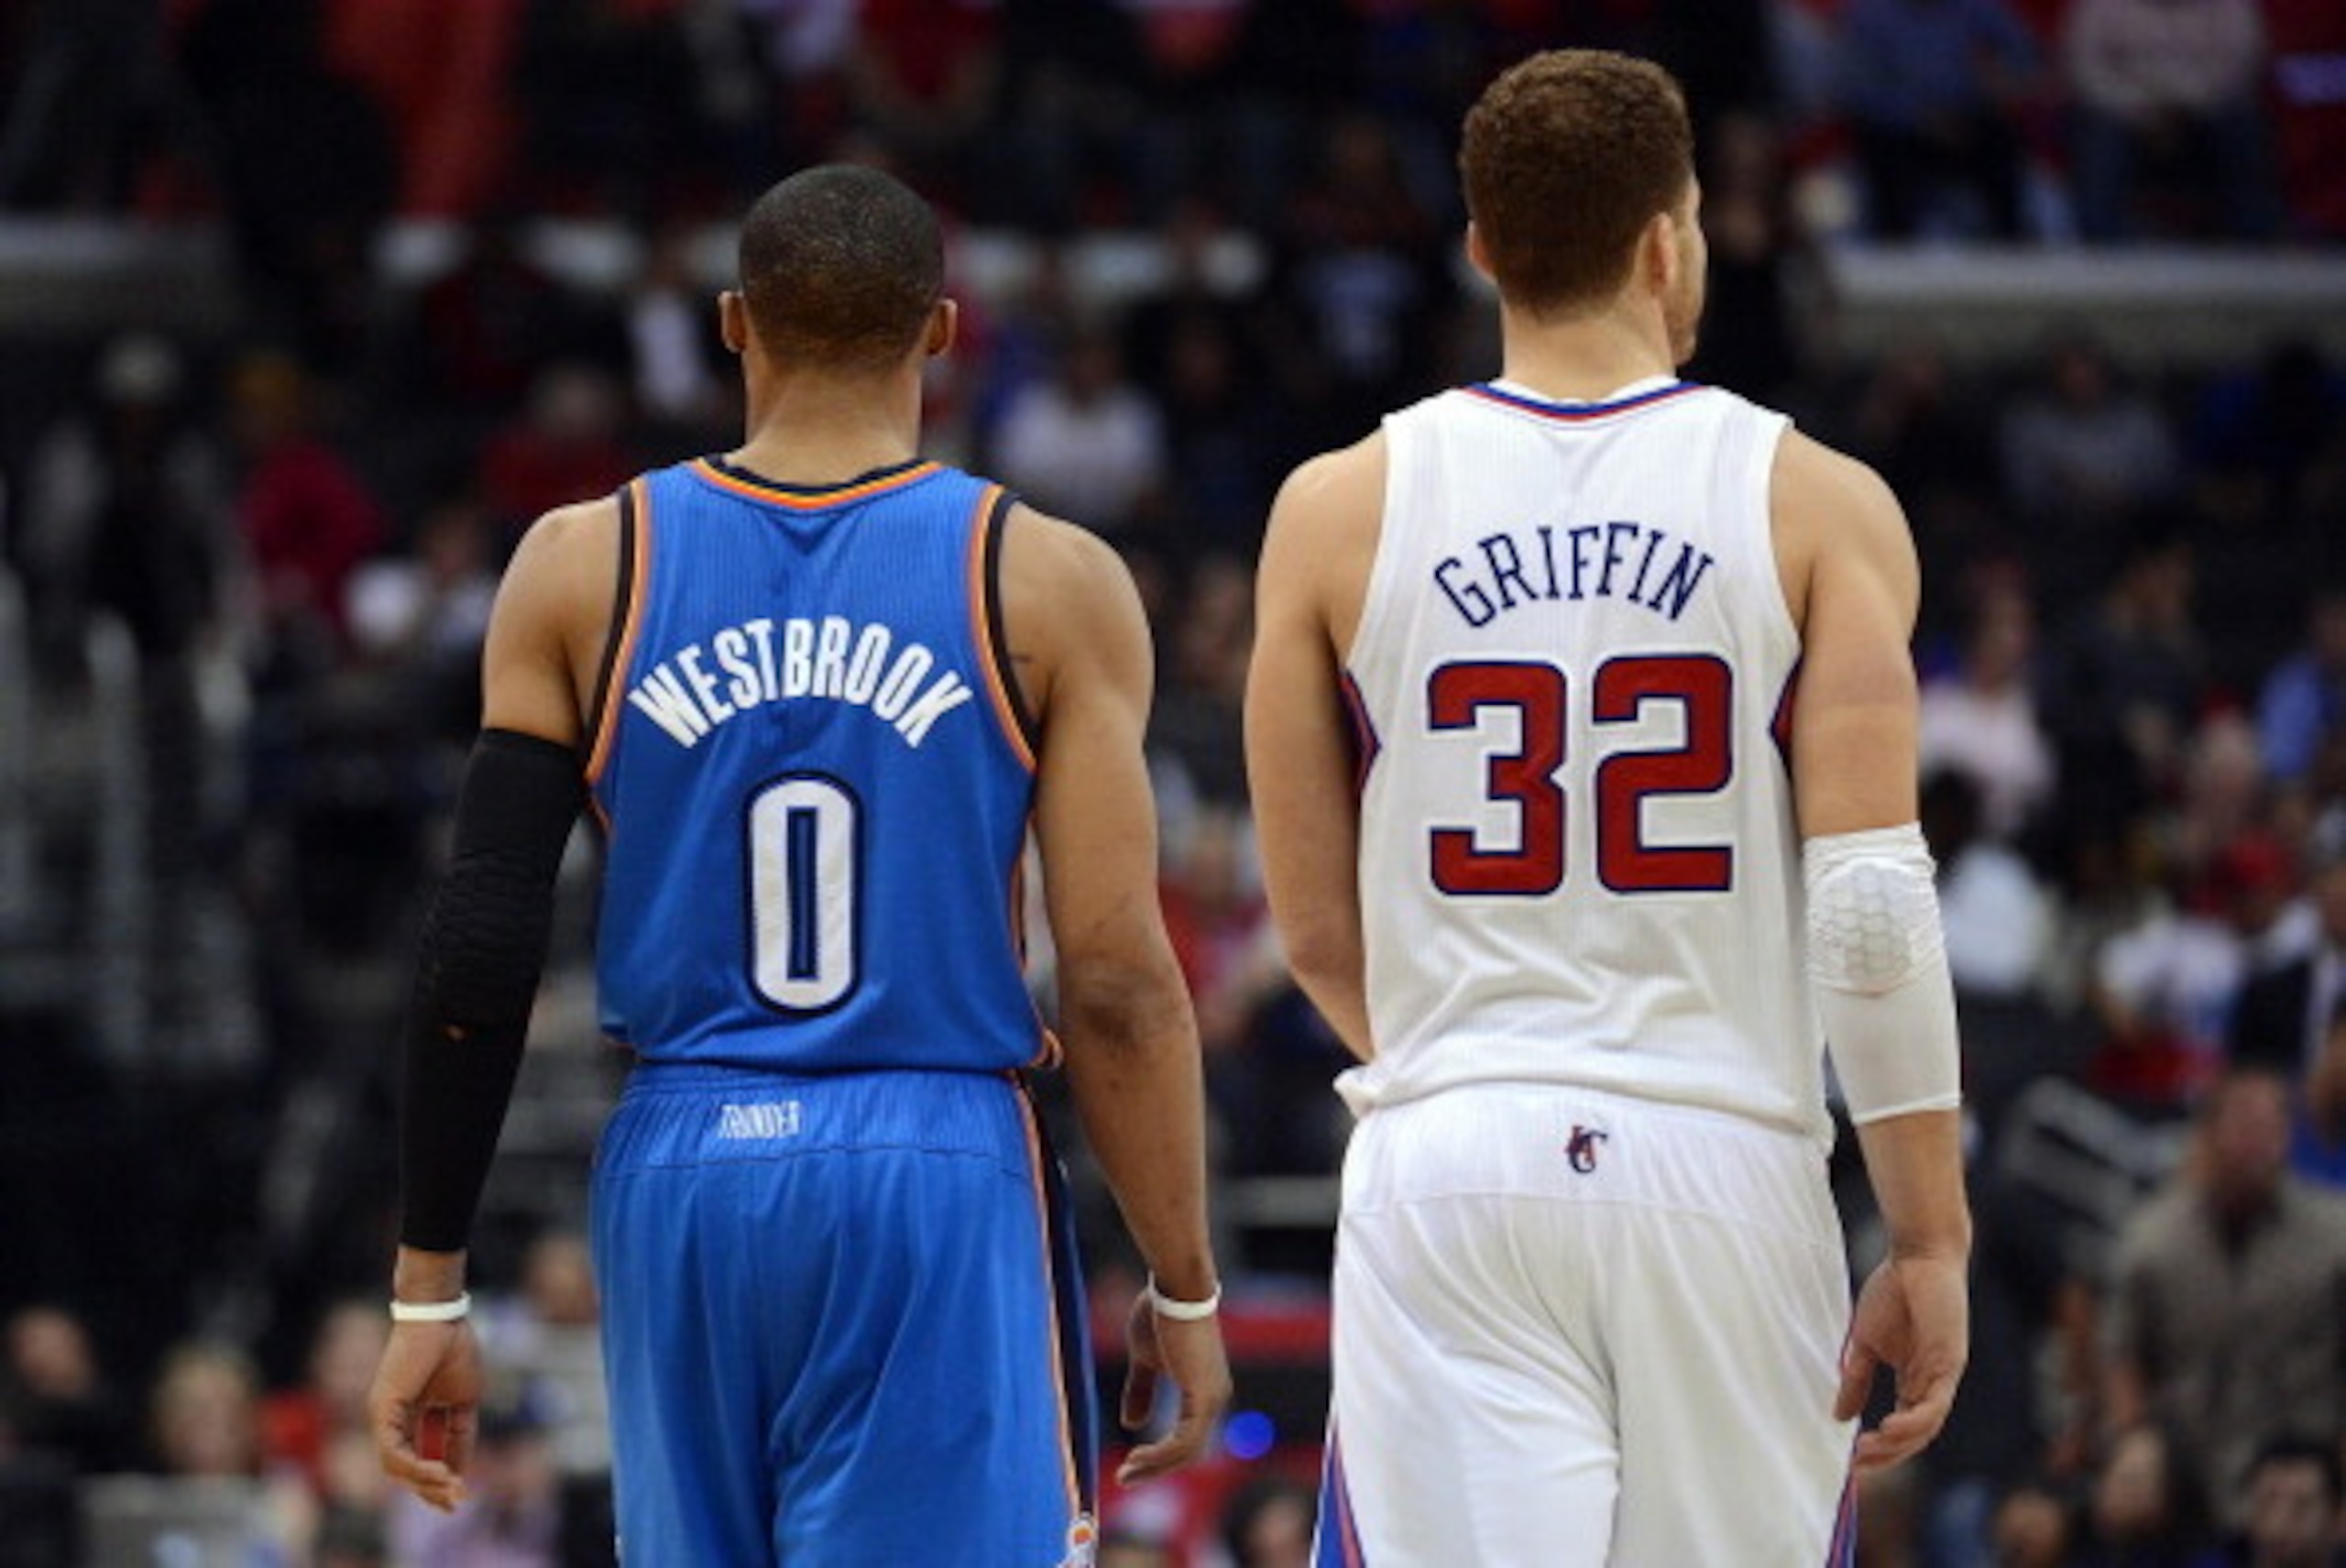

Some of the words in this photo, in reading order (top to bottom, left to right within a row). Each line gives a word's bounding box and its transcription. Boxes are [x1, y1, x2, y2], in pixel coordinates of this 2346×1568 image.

[1433, 521, 1715, 628] GRIFFIN
[628, 616, 973, 749] WESTBROOK
[1426, 653, 1733, 896] 32
[744, 771, 864, 1018] 0
